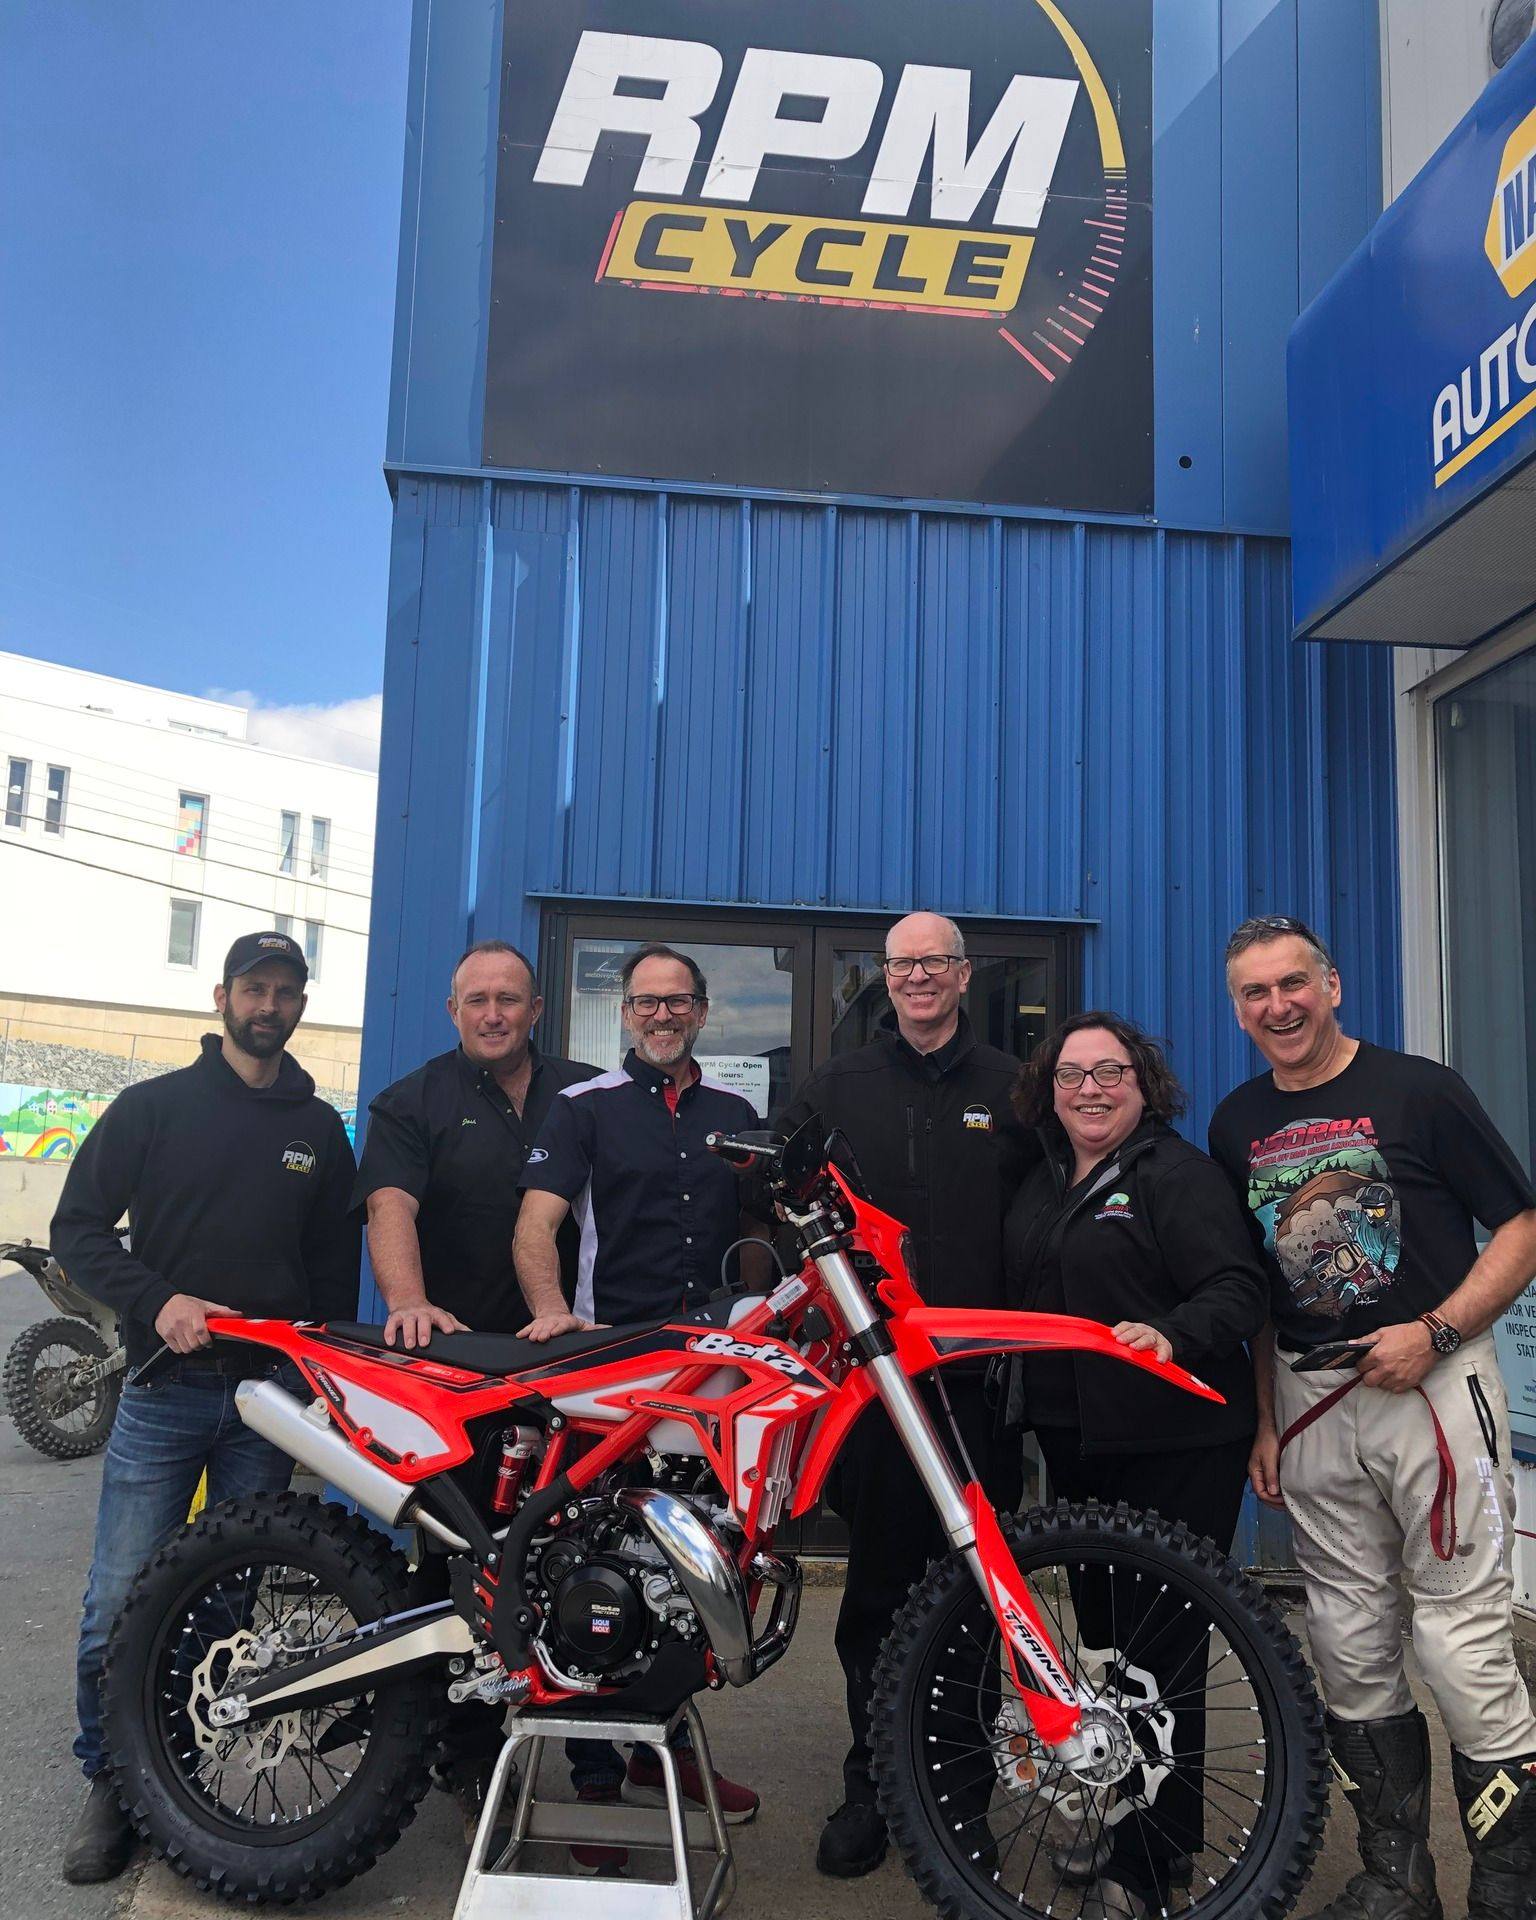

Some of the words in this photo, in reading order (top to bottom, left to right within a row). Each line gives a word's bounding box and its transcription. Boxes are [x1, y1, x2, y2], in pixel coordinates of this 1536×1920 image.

[532, 30, 1080, 228] RPM
[633, 212, 1010, 299] CYCLE
[718, 1061, 741, 1070] Cycle
[742, 1061, 763, 1070] Open
[718, 1071, 744, 1079] Hours:
[962, 1112, 991, 1123] RPM
[281, 1150, 314, 1168] RPM
[694, 1333, 805, 1375] Beta
[592, 1619, 610, 1627] LIQUI
[592, 1625, 611, 1634] MOLY
